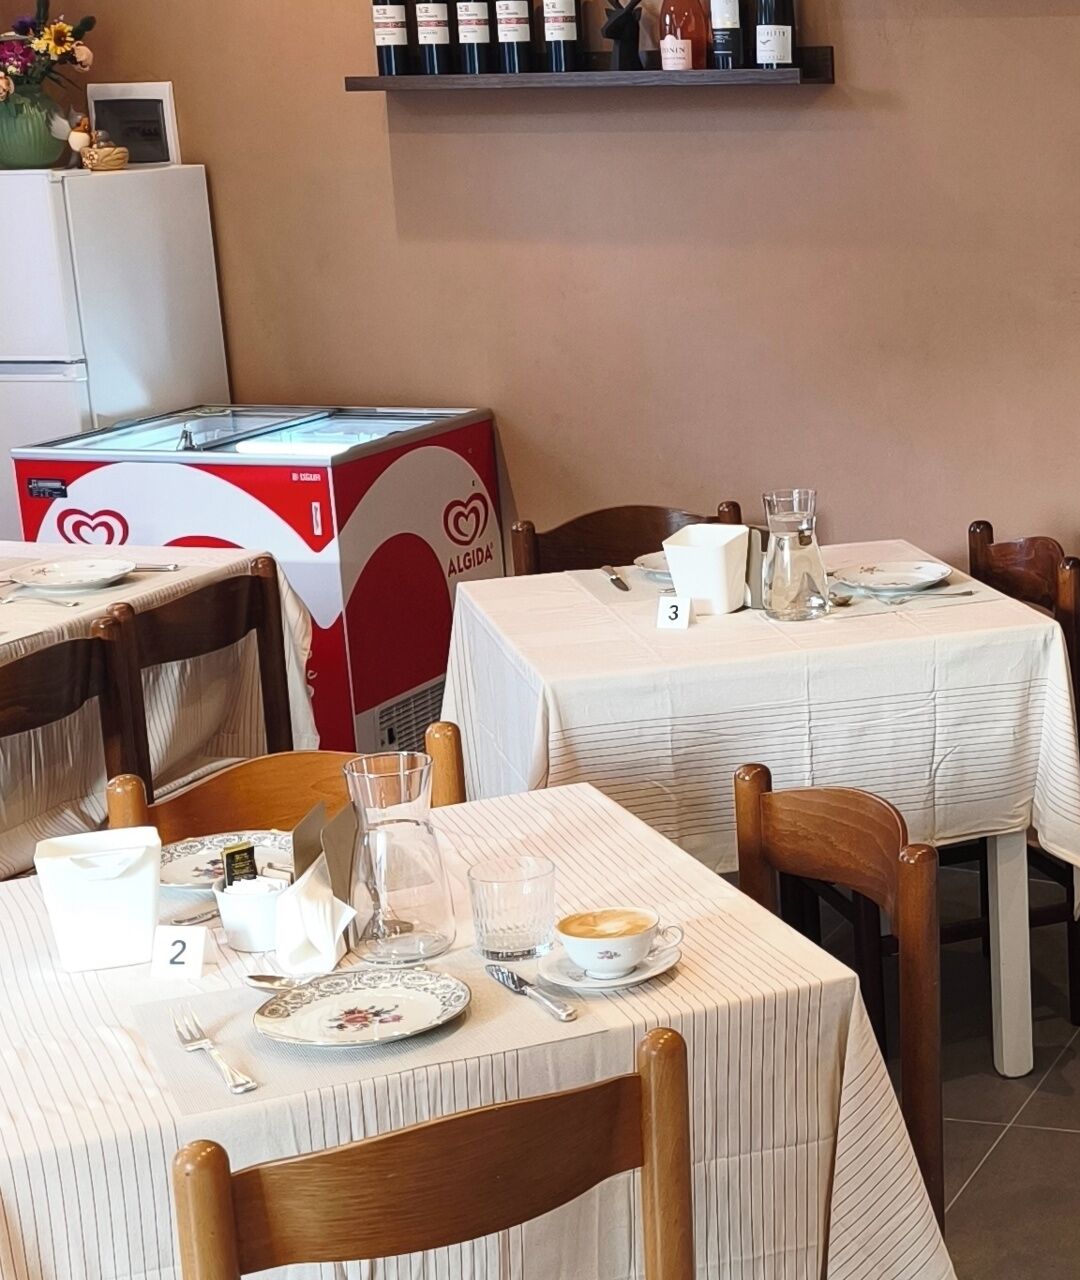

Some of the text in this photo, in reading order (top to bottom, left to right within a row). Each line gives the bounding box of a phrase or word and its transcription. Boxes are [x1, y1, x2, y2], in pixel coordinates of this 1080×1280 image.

[447, 543, 493, 578] ALGIDA
[668, 604, 679, 621] 3
[169, 939, 187, 965] 2
